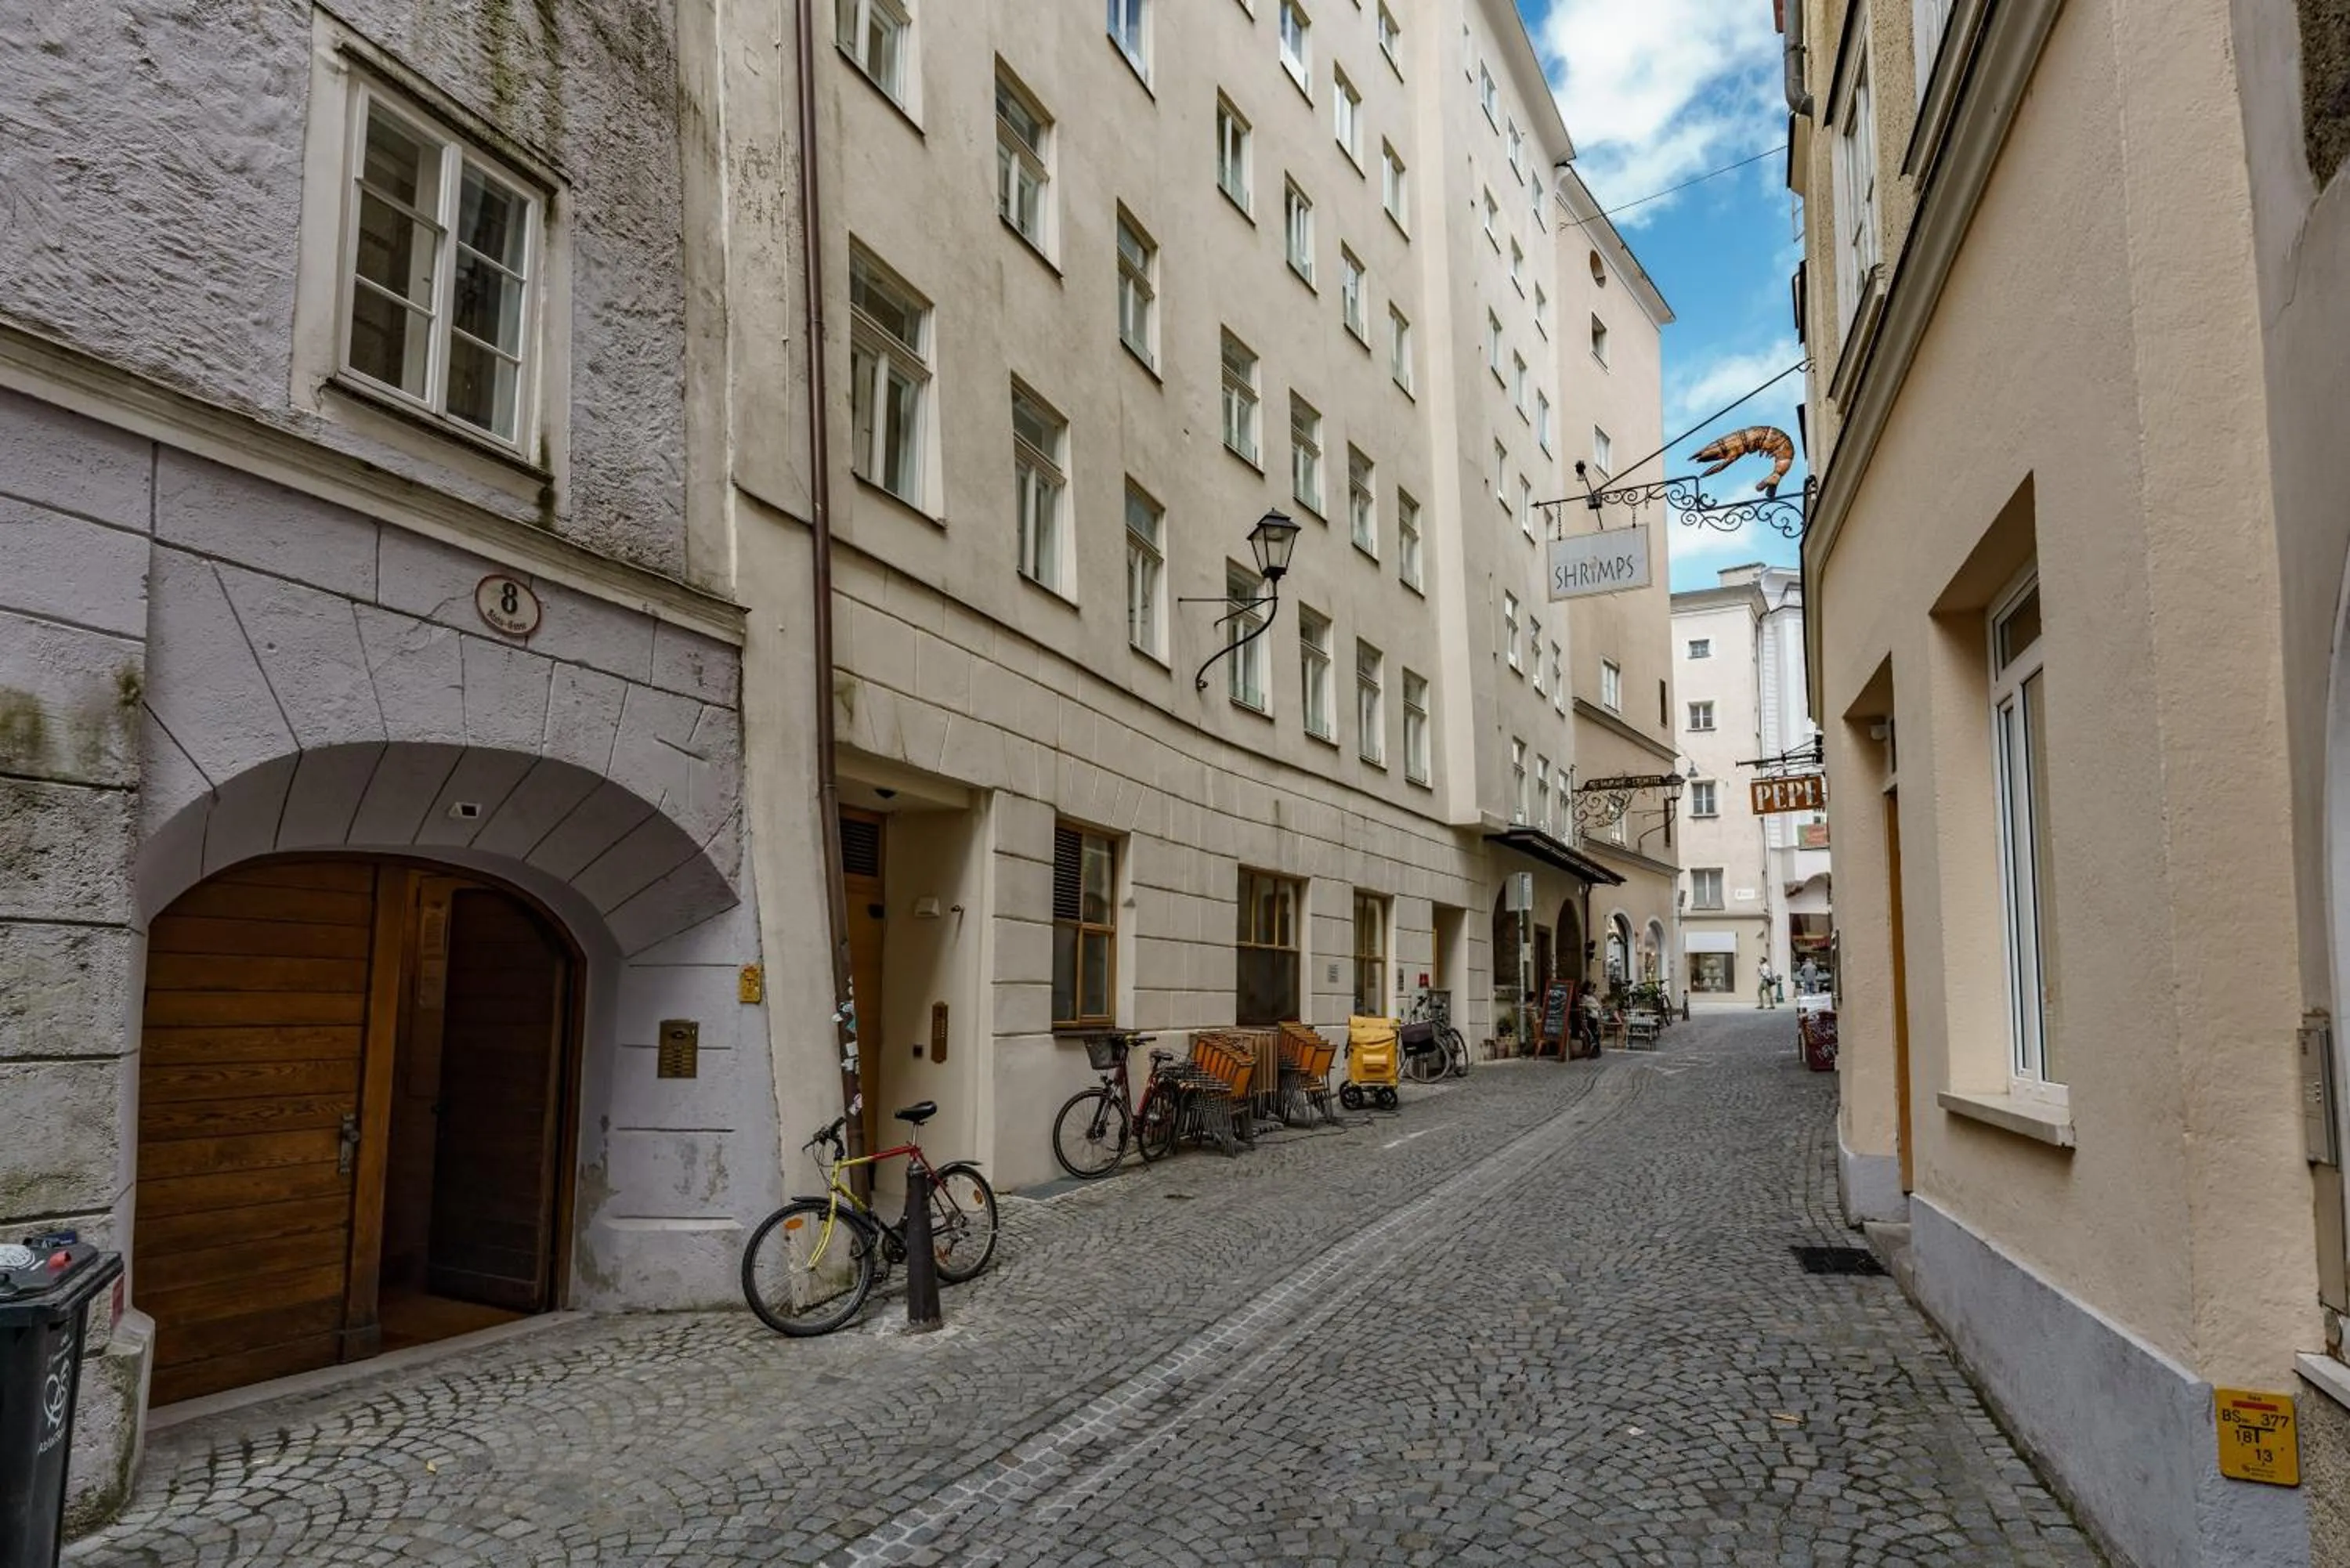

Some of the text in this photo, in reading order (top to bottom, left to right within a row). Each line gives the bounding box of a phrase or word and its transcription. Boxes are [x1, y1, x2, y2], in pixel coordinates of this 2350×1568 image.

[1555, 554, 1635, 589] SHRIMPS
[501, 582, 517, 615] 8
[1755, 779, 1818, 811] PEPE
[2261, 1413, 2290, 1429] 377
